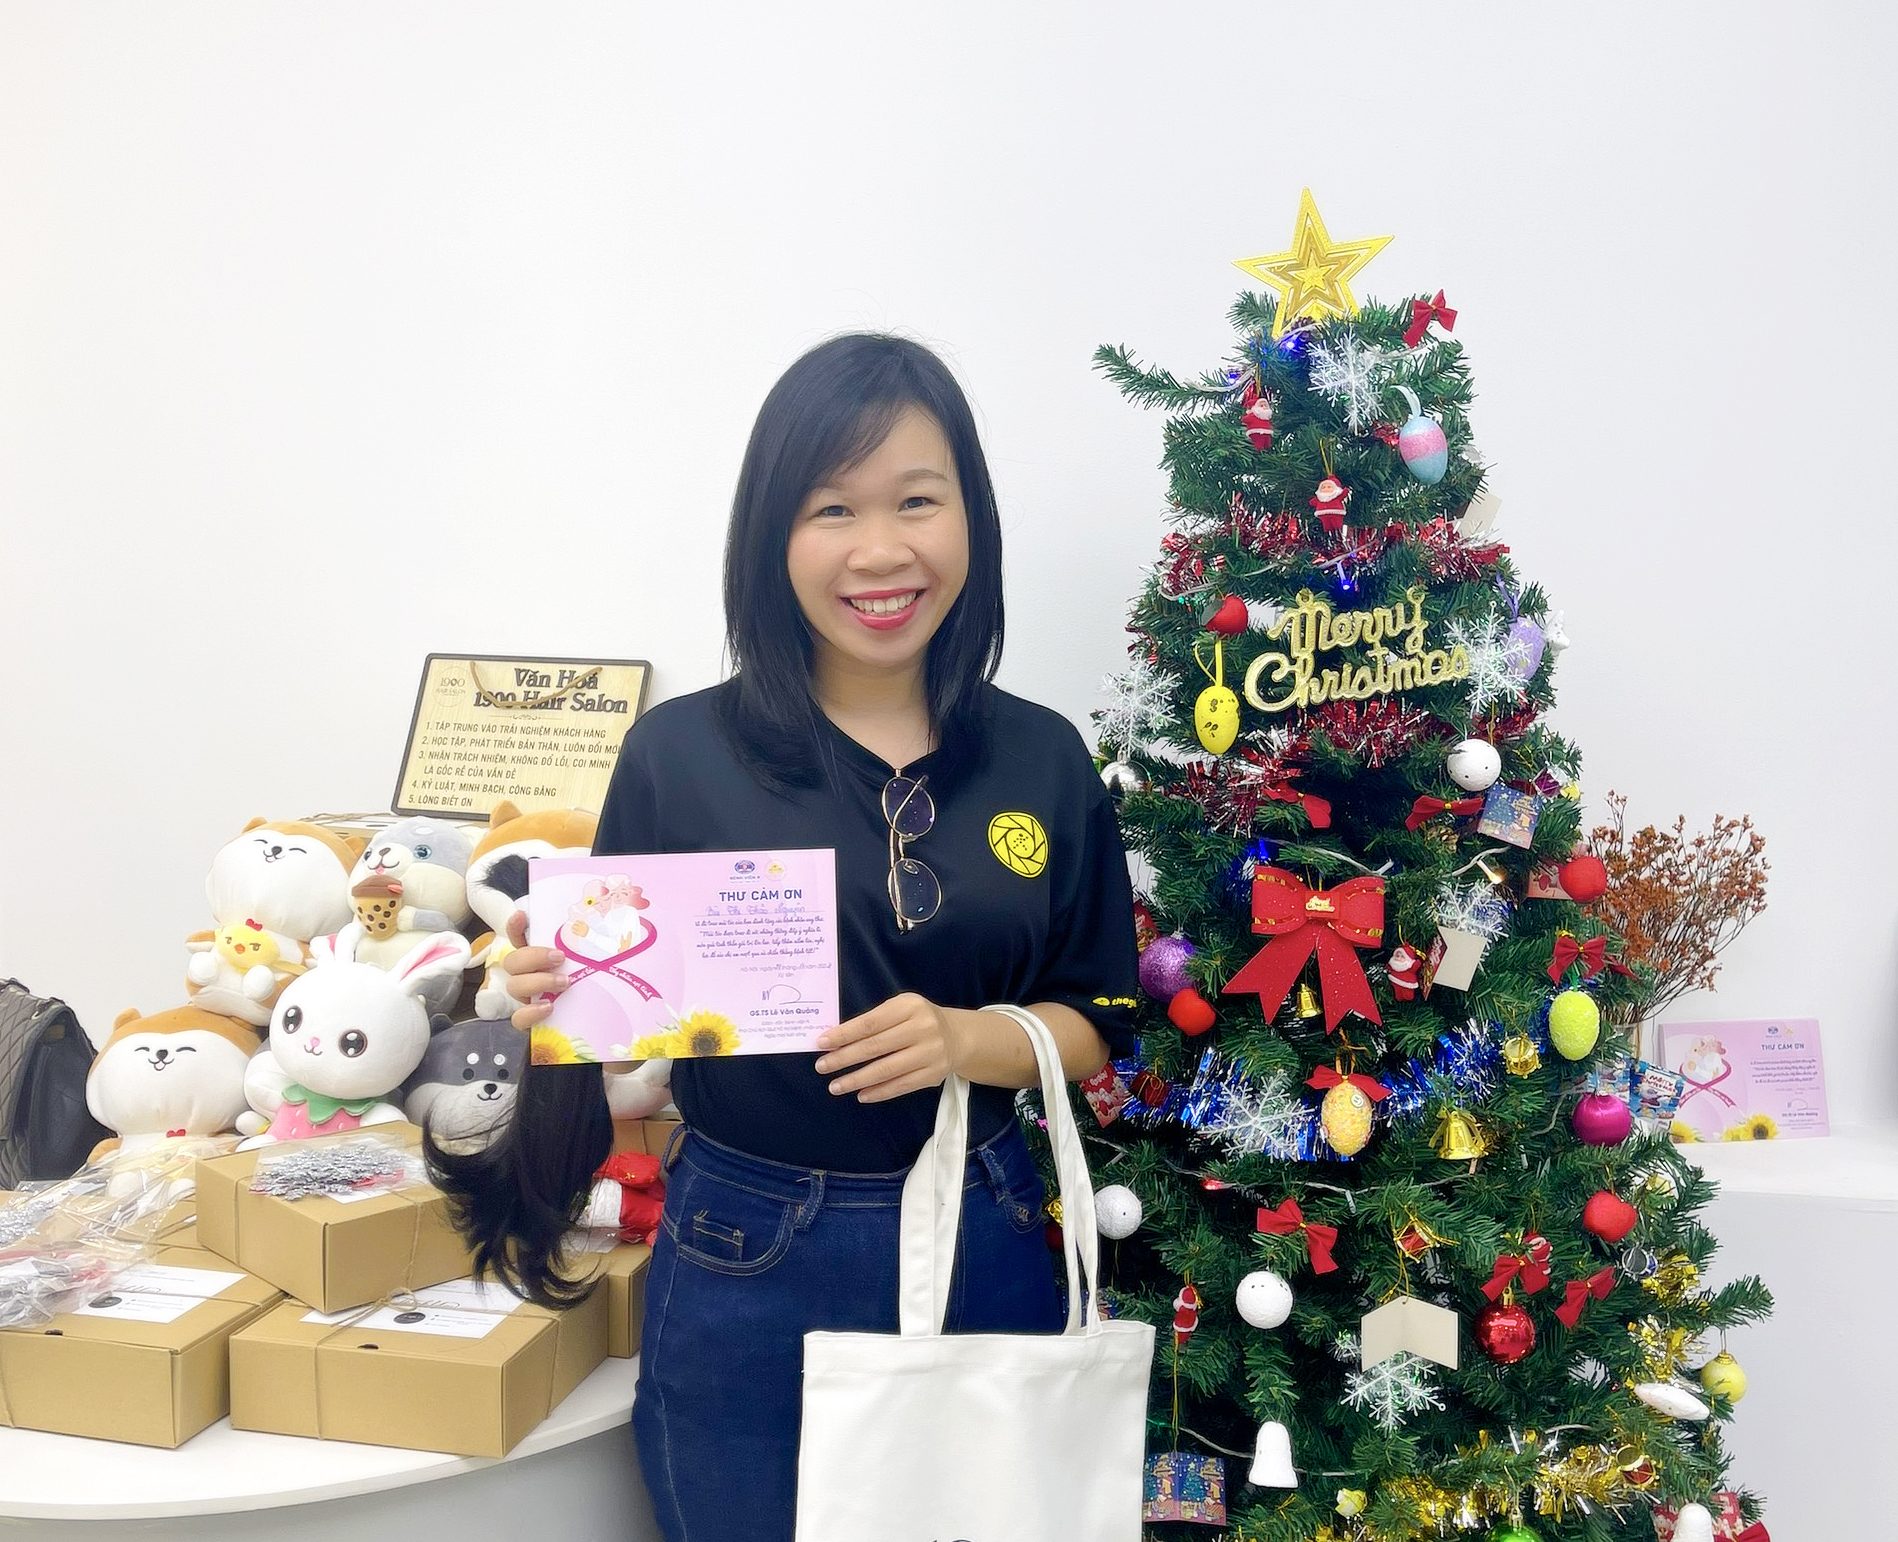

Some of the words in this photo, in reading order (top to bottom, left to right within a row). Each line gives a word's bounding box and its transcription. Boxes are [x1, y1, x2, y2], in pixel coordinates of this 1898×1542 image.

[1267, 588, 1428, 655] Merry
[440, 677, 466, 687] 1900
[514, 668, 551, 688] Văn
[1244, 643, 1471, 713] Christmas
[473, 690, 517, 708] 1900
[521, 690, 567, 710] Hair
[570, 692, 628, 714] Salon
[426, 722, 432, 730] 1.
[436, 721, 450, 732] TẬP
[453, 722, 478, 732] TRUNG
[481, 723, 497, 734] VÀO
[500, 723, 517, 734] TRẢI
[520, 725, 550, 736] NGHIỆM
[553, 727, 581, 737] KHÁCH
[583, 728, 606, 739] HÀNG
[422, 736, 428, 745] 2.
[431, 737, 448, 747] HỌC
[470, 738, 491, 748] PHÁT
[518, 739, 535, 750] BẢN
[538, 740, 560, 752] THÂN,
[564, 742, 585, 752] LUÔN
[588, 741, 602, 753] ĐỔI
[419, 751, 426, 759] 3.
[428, 750, 450, 761] NHẬN
[453, 751, 478, 762] TRÁCH
[481, 753, 507, 765] NHIỆM,
[511, 755, 538, 766] KHÔNG
[572, 758, 587, 768] COI
[589, 759, 611, 769] MÌNH
[424, 765, 434, 775] LÀ
[436, 764, 453, 775] GỐC
[467, 766, 484, 777] CỦA
[487, 767, 503, 778] VẤN
[506, 768, 516, 779] ĐỀ
[412, 779, 419, 789] 4.
[422, 778, 433, 789] KỶ
[435, 780, 456, 792] LUẬT,
[459, 782, 480, 792] MINH
[482, 784, 505, 795] BẠCH,
[509, 785, 531, 795] CÔNG
[534, 785, 556, 797] BẰNG
[408, 794, 415, 803] 5.
[418, 794, 440, 805] LÒNG
[441, 794, 459, 806] BIẾT
[461, 797, 473, 807] ƠN
[719, 891, 747, 901] THƯ
[751, 887, 779, 900] CẢM
[784, 889, 802, 900] ƠN
